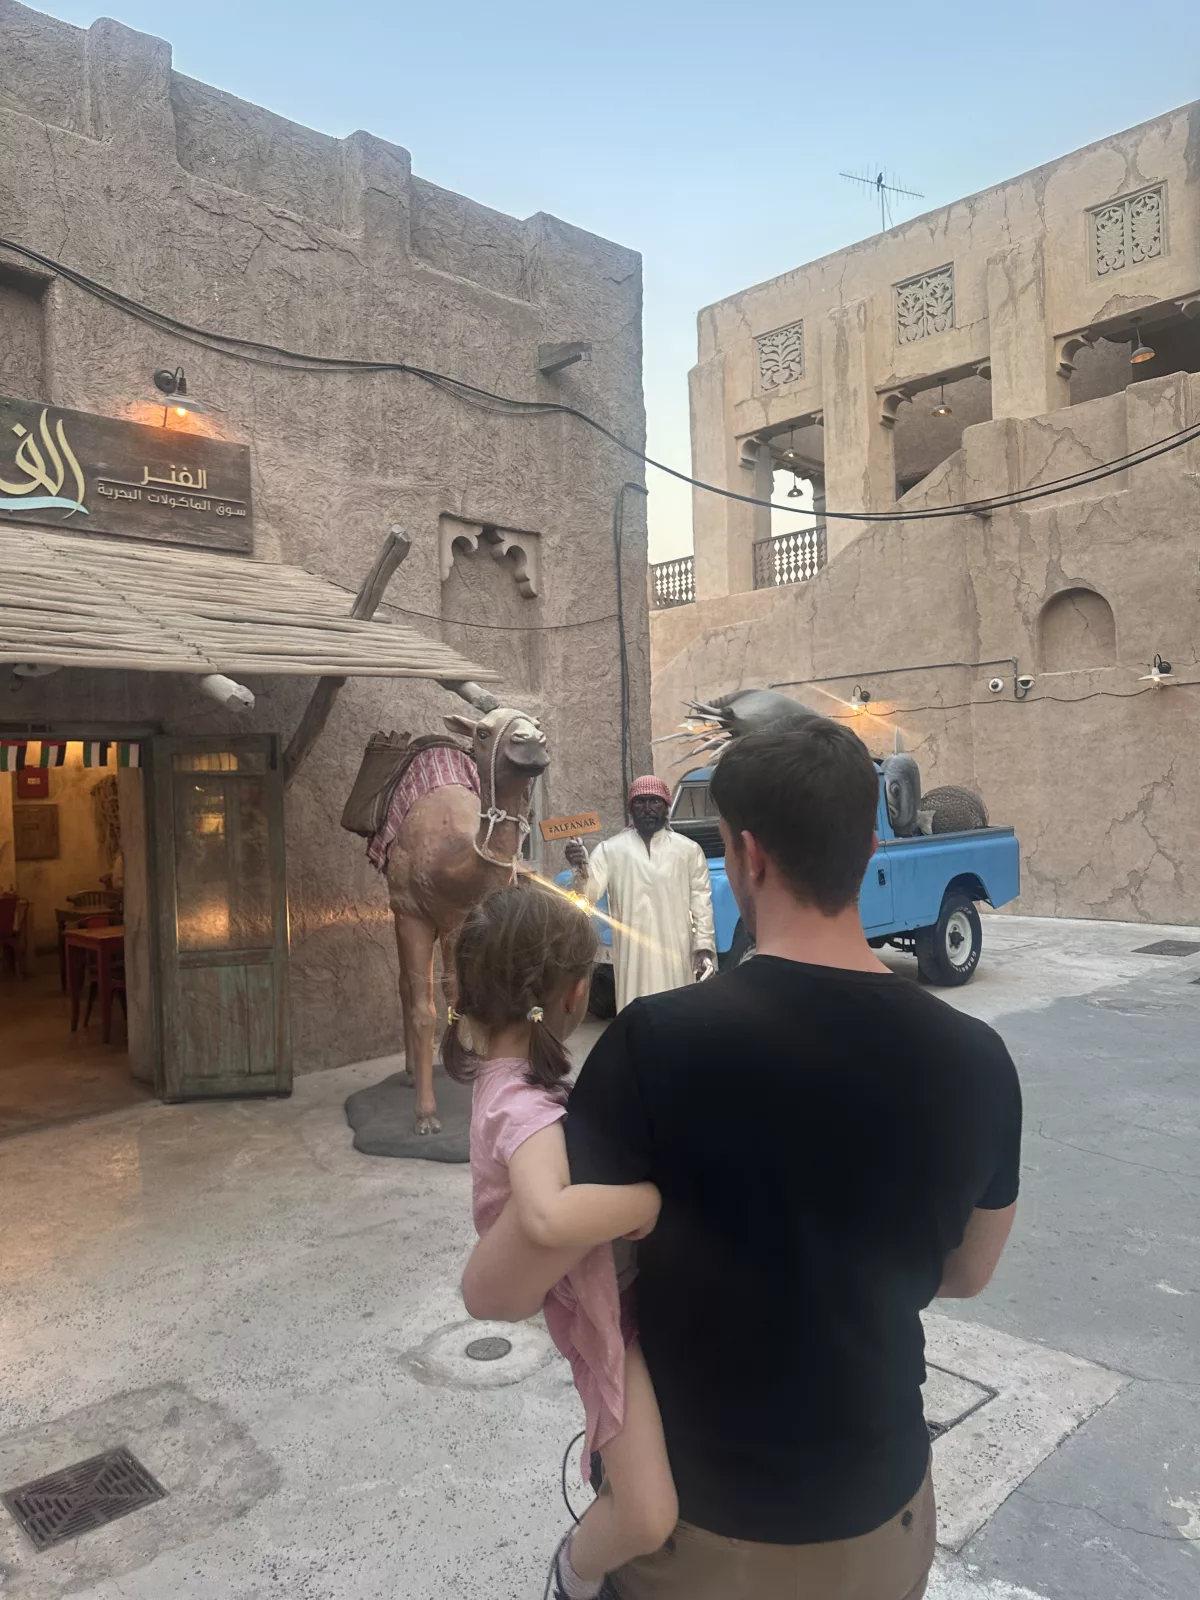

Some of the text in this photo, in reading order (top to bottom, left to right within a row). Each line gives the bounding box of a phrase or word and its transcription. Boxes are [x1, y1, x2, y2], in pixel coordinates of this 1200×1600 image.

[140, 464, 208, 490] الفنر
[97, 482, 142, 501] البحرية
[215, 502, 247, 517] سوق
